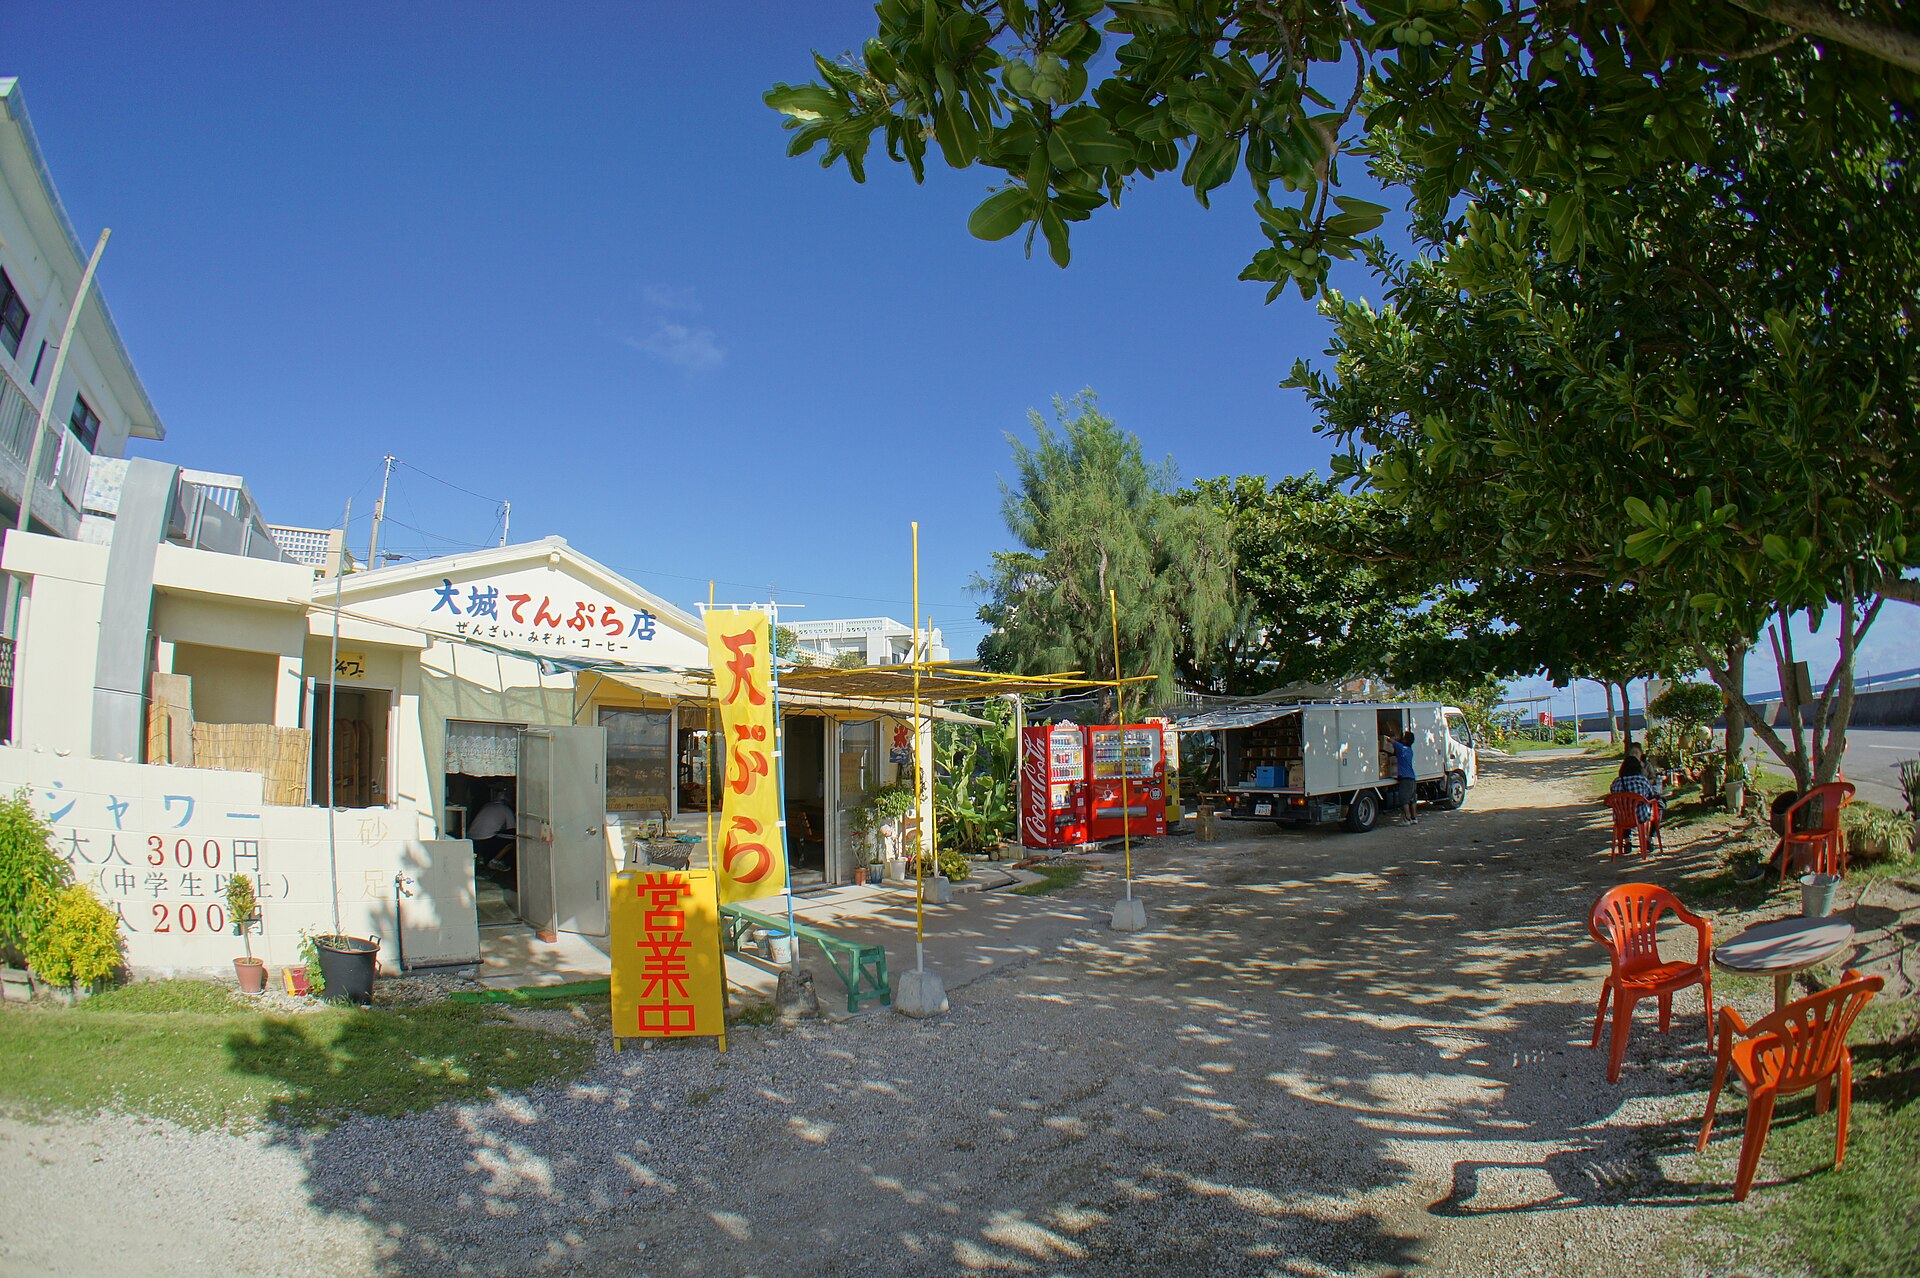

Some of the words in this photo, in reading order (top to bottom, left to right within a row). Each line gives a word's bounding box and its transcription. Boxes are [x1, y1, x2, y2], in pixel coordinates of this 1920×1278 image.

[431, 579, 657, 641] 大城てんぷら店
[456, 621, 629, 652] ぜんざい・みぞれ・コーヒー
[721, 629, 775, 884] 天ぷら
[46, 780, 261, 829] シャワー
[637, 873, 696, 1035] 営業中
